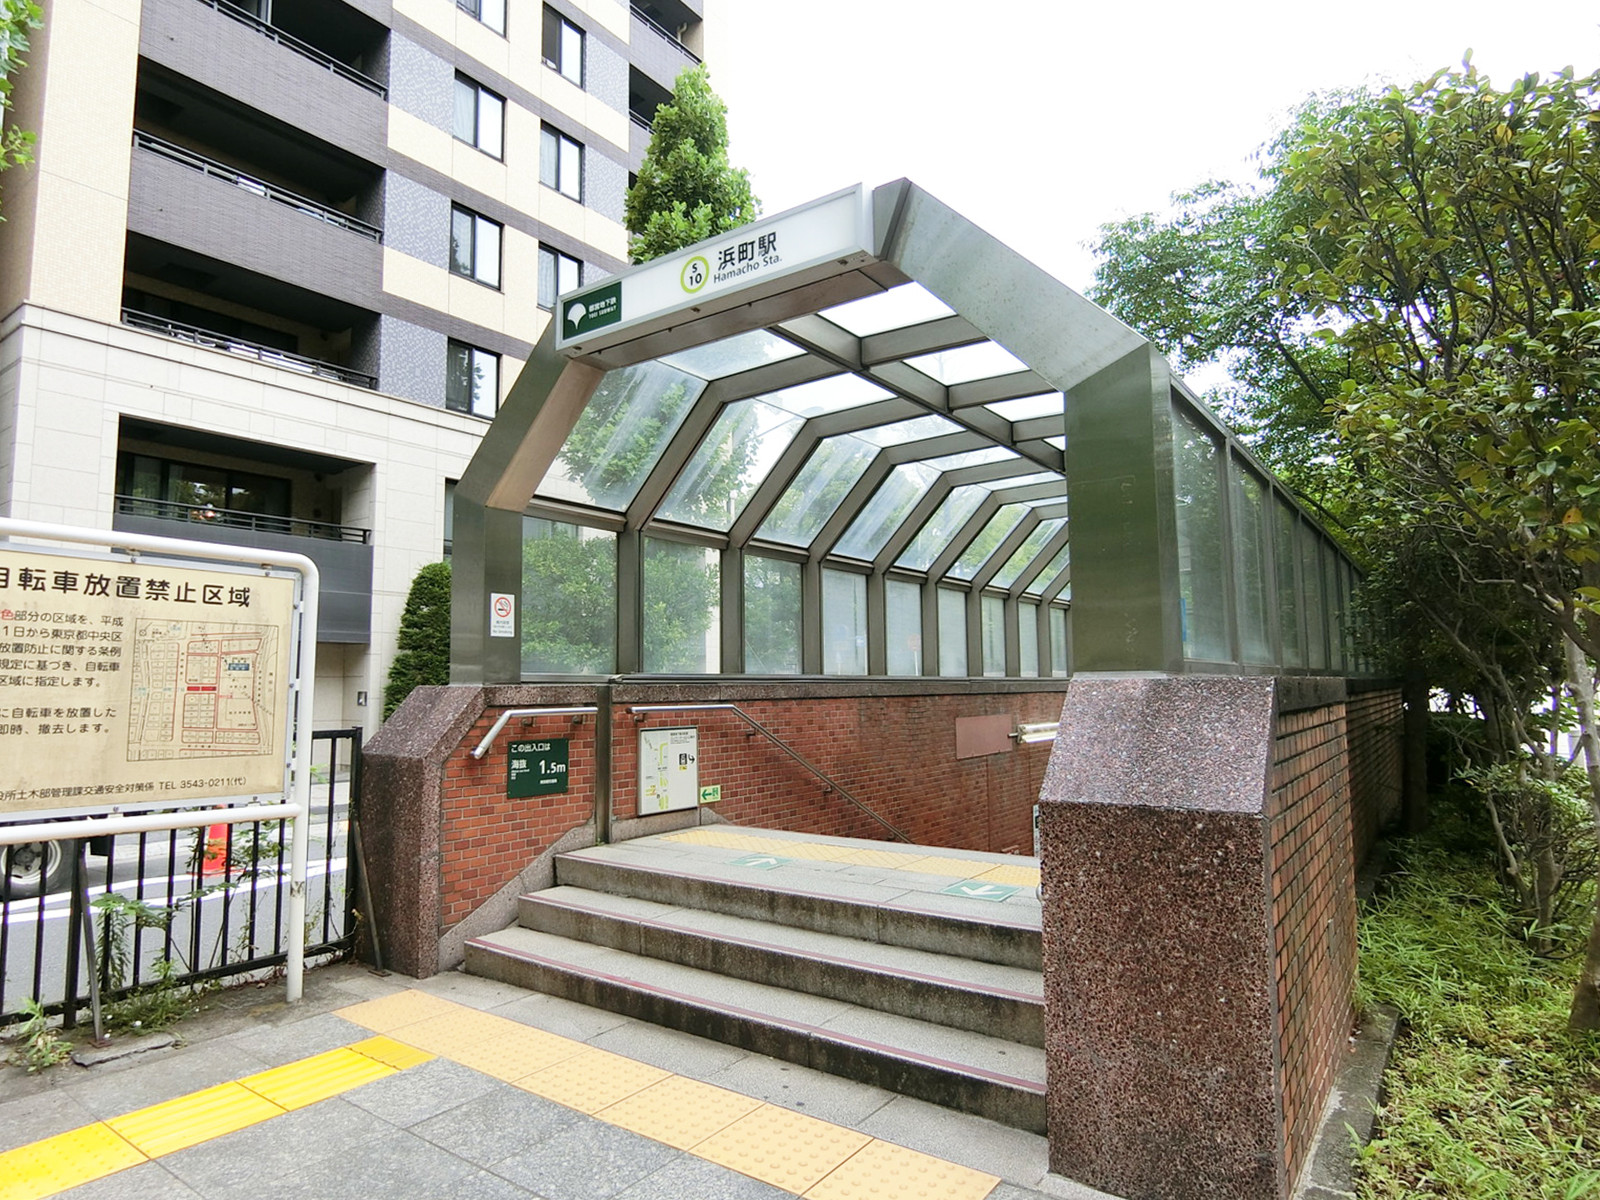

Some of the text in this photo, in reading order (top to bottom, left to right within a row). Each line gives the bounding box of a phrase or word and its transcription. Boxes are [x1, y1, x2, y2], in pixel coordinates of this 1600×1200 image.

[717, 231, 777, 272] 浜町駅
[691, 262, 698, 273] S
[713, 254, 783, 284] Hamacho Sta.
[689, 273, 703, 286] 10
[0, 642, 121, 658] 放置防止に関する条例
[511, 743, 551, 753] この出入口は
[539, 759, 566, 775] 1.5m
[159, 781, 177, 791] TEL
